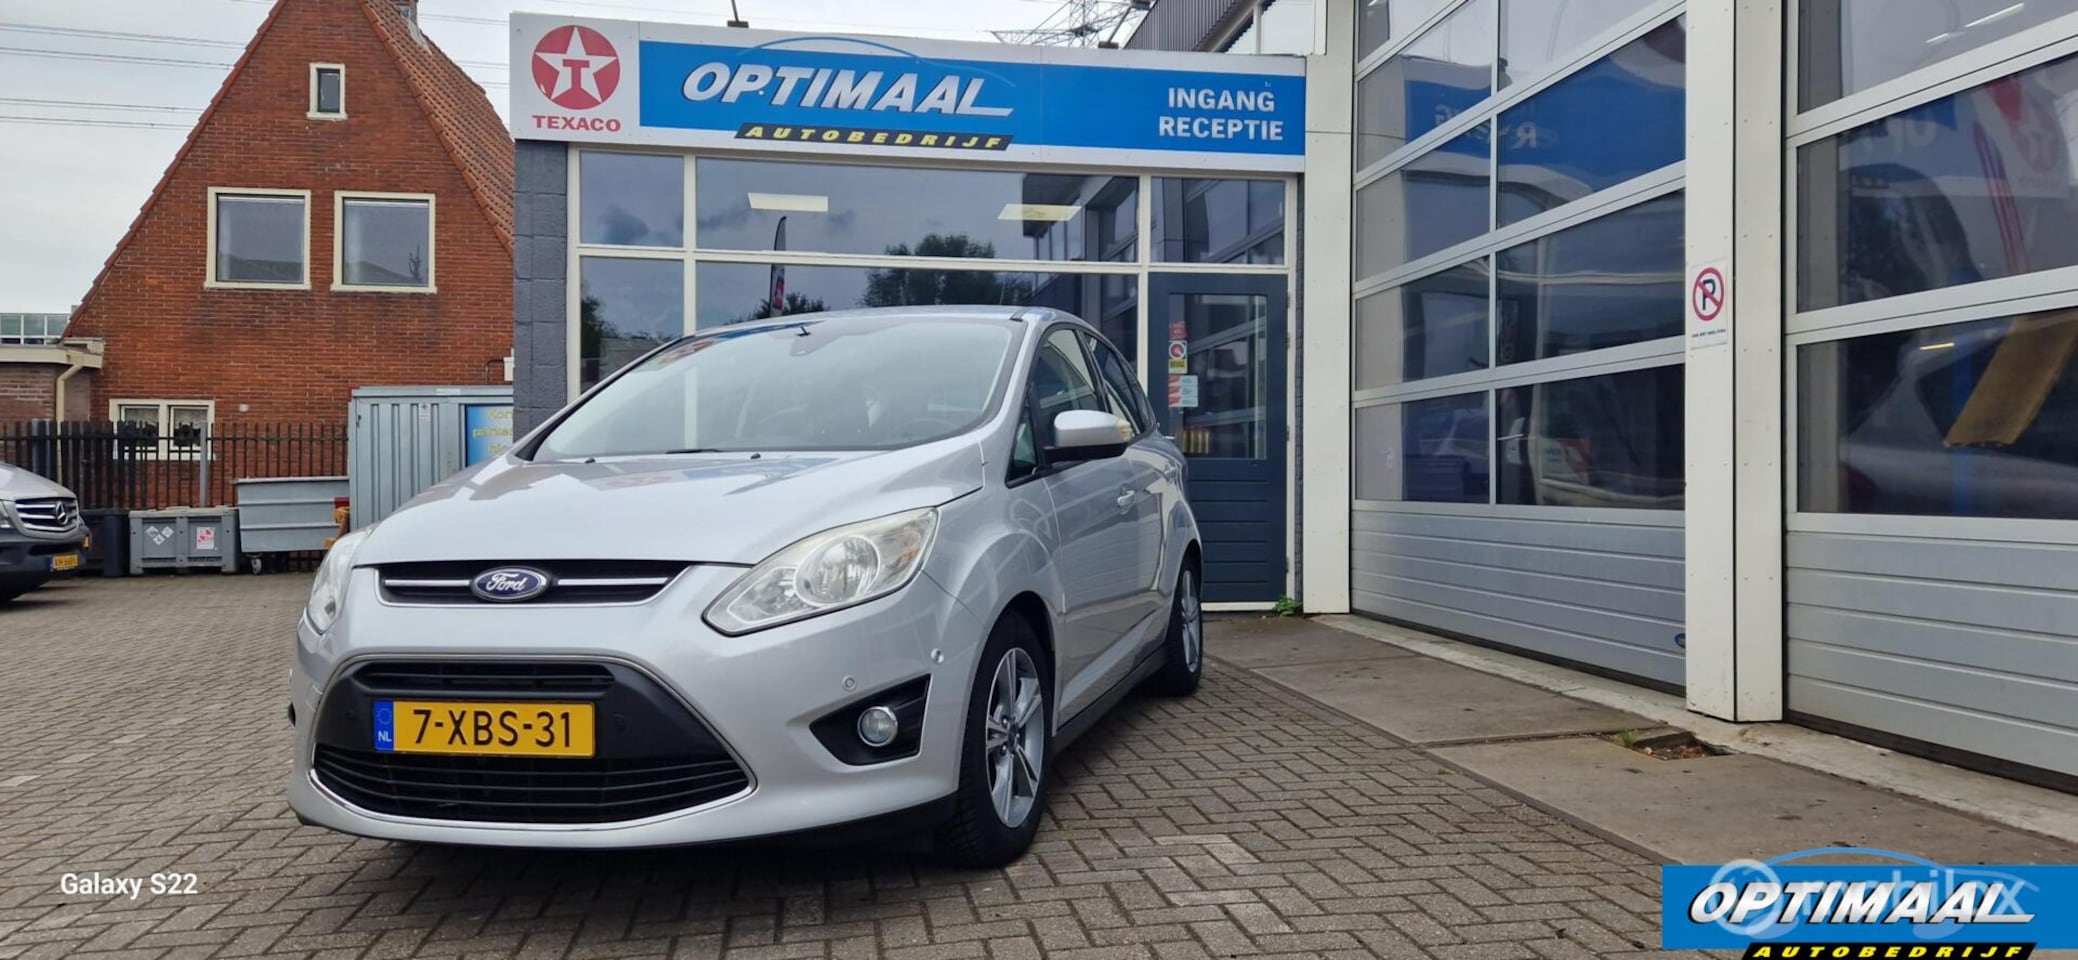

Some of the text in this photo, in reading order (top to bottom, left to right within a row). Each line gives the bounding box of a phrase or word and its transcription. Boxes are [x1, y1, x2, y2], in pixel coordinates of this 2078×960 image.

[681, 61, 1014, 117] OPTIMAAL
[1168, 87, 1275, 112] INGANG
[532, 115, 622, 132] TEXACO
[1159, 115, 1283, 141] RECEPTIE
[744, 126, 1002, 149] AUTOBEDRIJF
[485, 572, 528, 591] Ford
[378, 731, 392, 743] NL
[412, 708, 571, 748] 7-XBS-31
